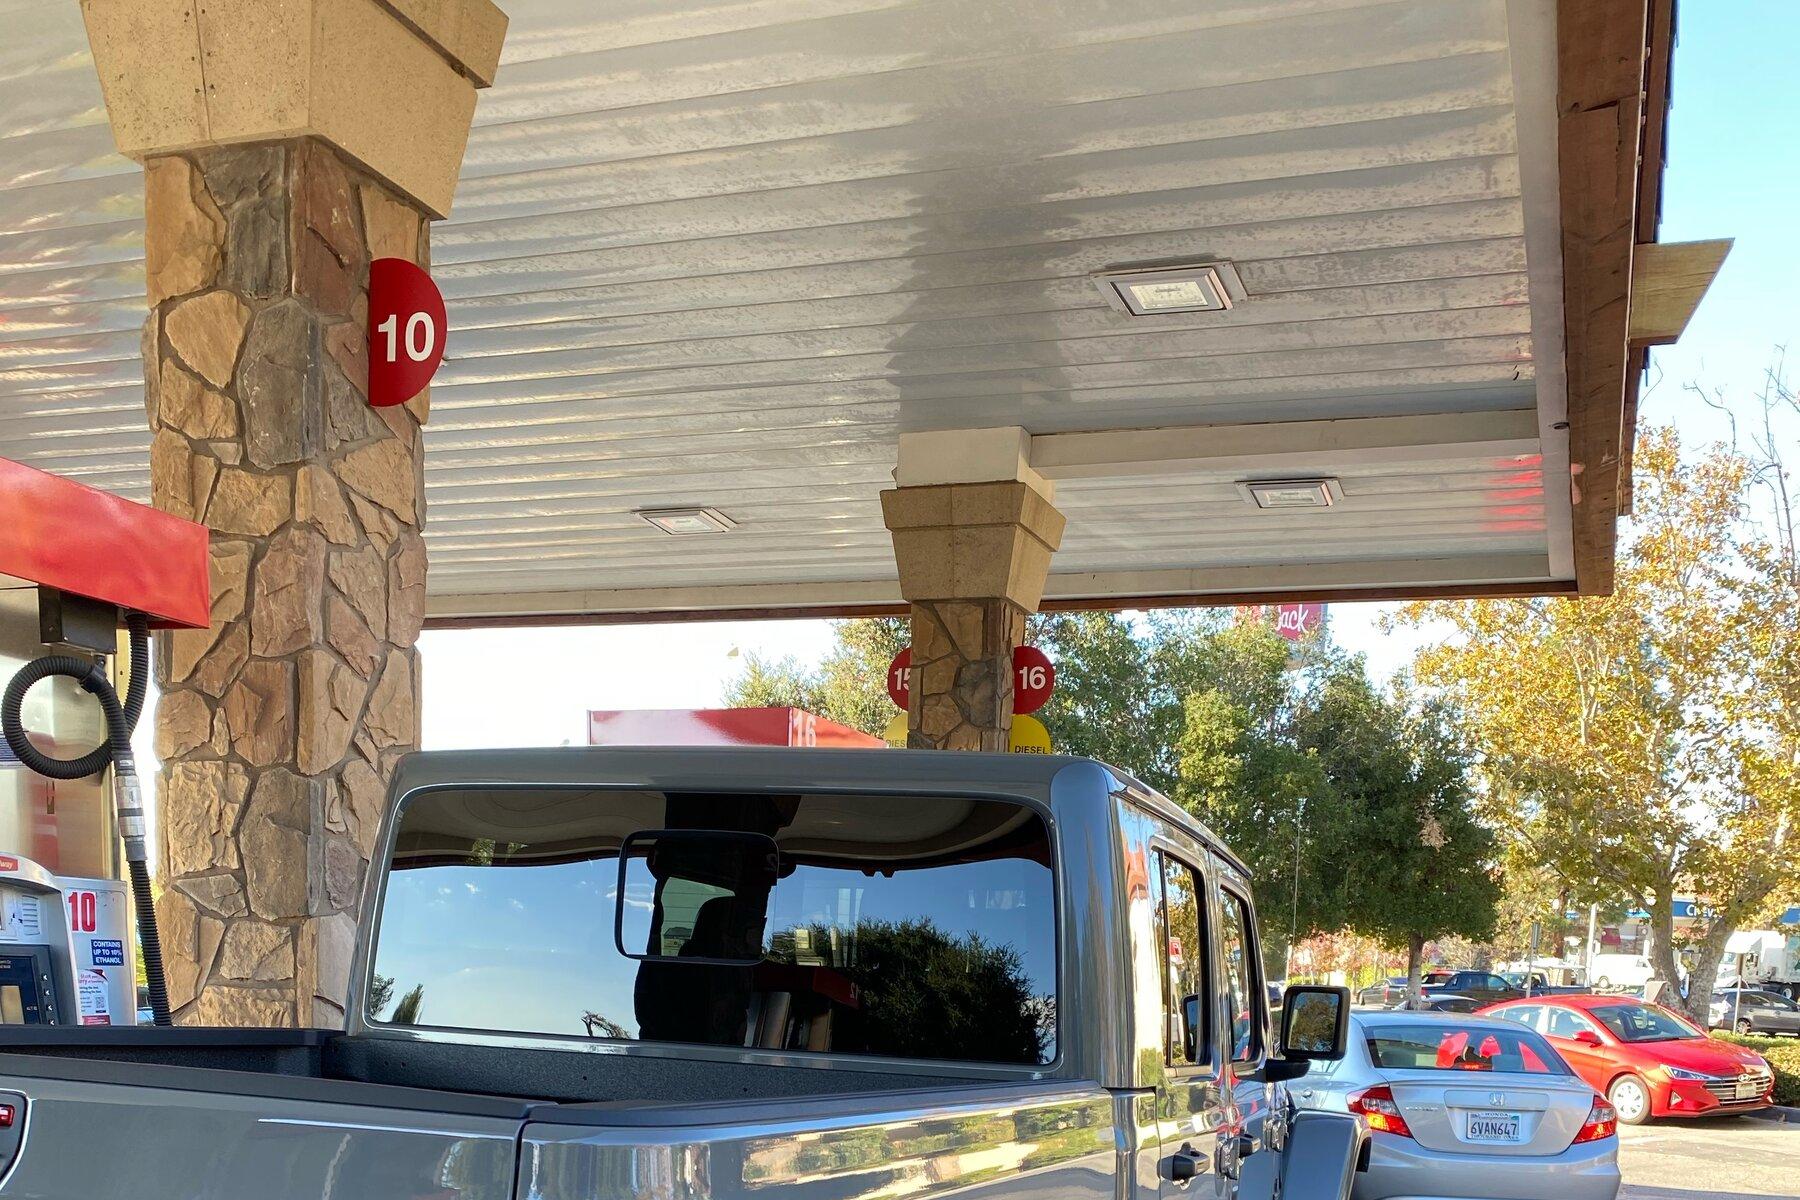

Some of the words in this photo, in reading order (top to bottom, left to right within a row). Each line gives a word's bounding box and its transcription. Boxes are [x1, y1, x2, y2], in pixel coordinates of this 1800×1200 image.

[378, 311, 435, 362] 10
[1275, 604, 1309, 635] Jack
[1019, 666, 1046, 690] 16
[793, 710, 817, 747] 16
[886, 740, 906, 748] DIES
[1014, 745, 1049, 754] DIESEL
[69, 891, 96, 932] 10
[1471, 1122, 1517, 1136] 6VAN647
